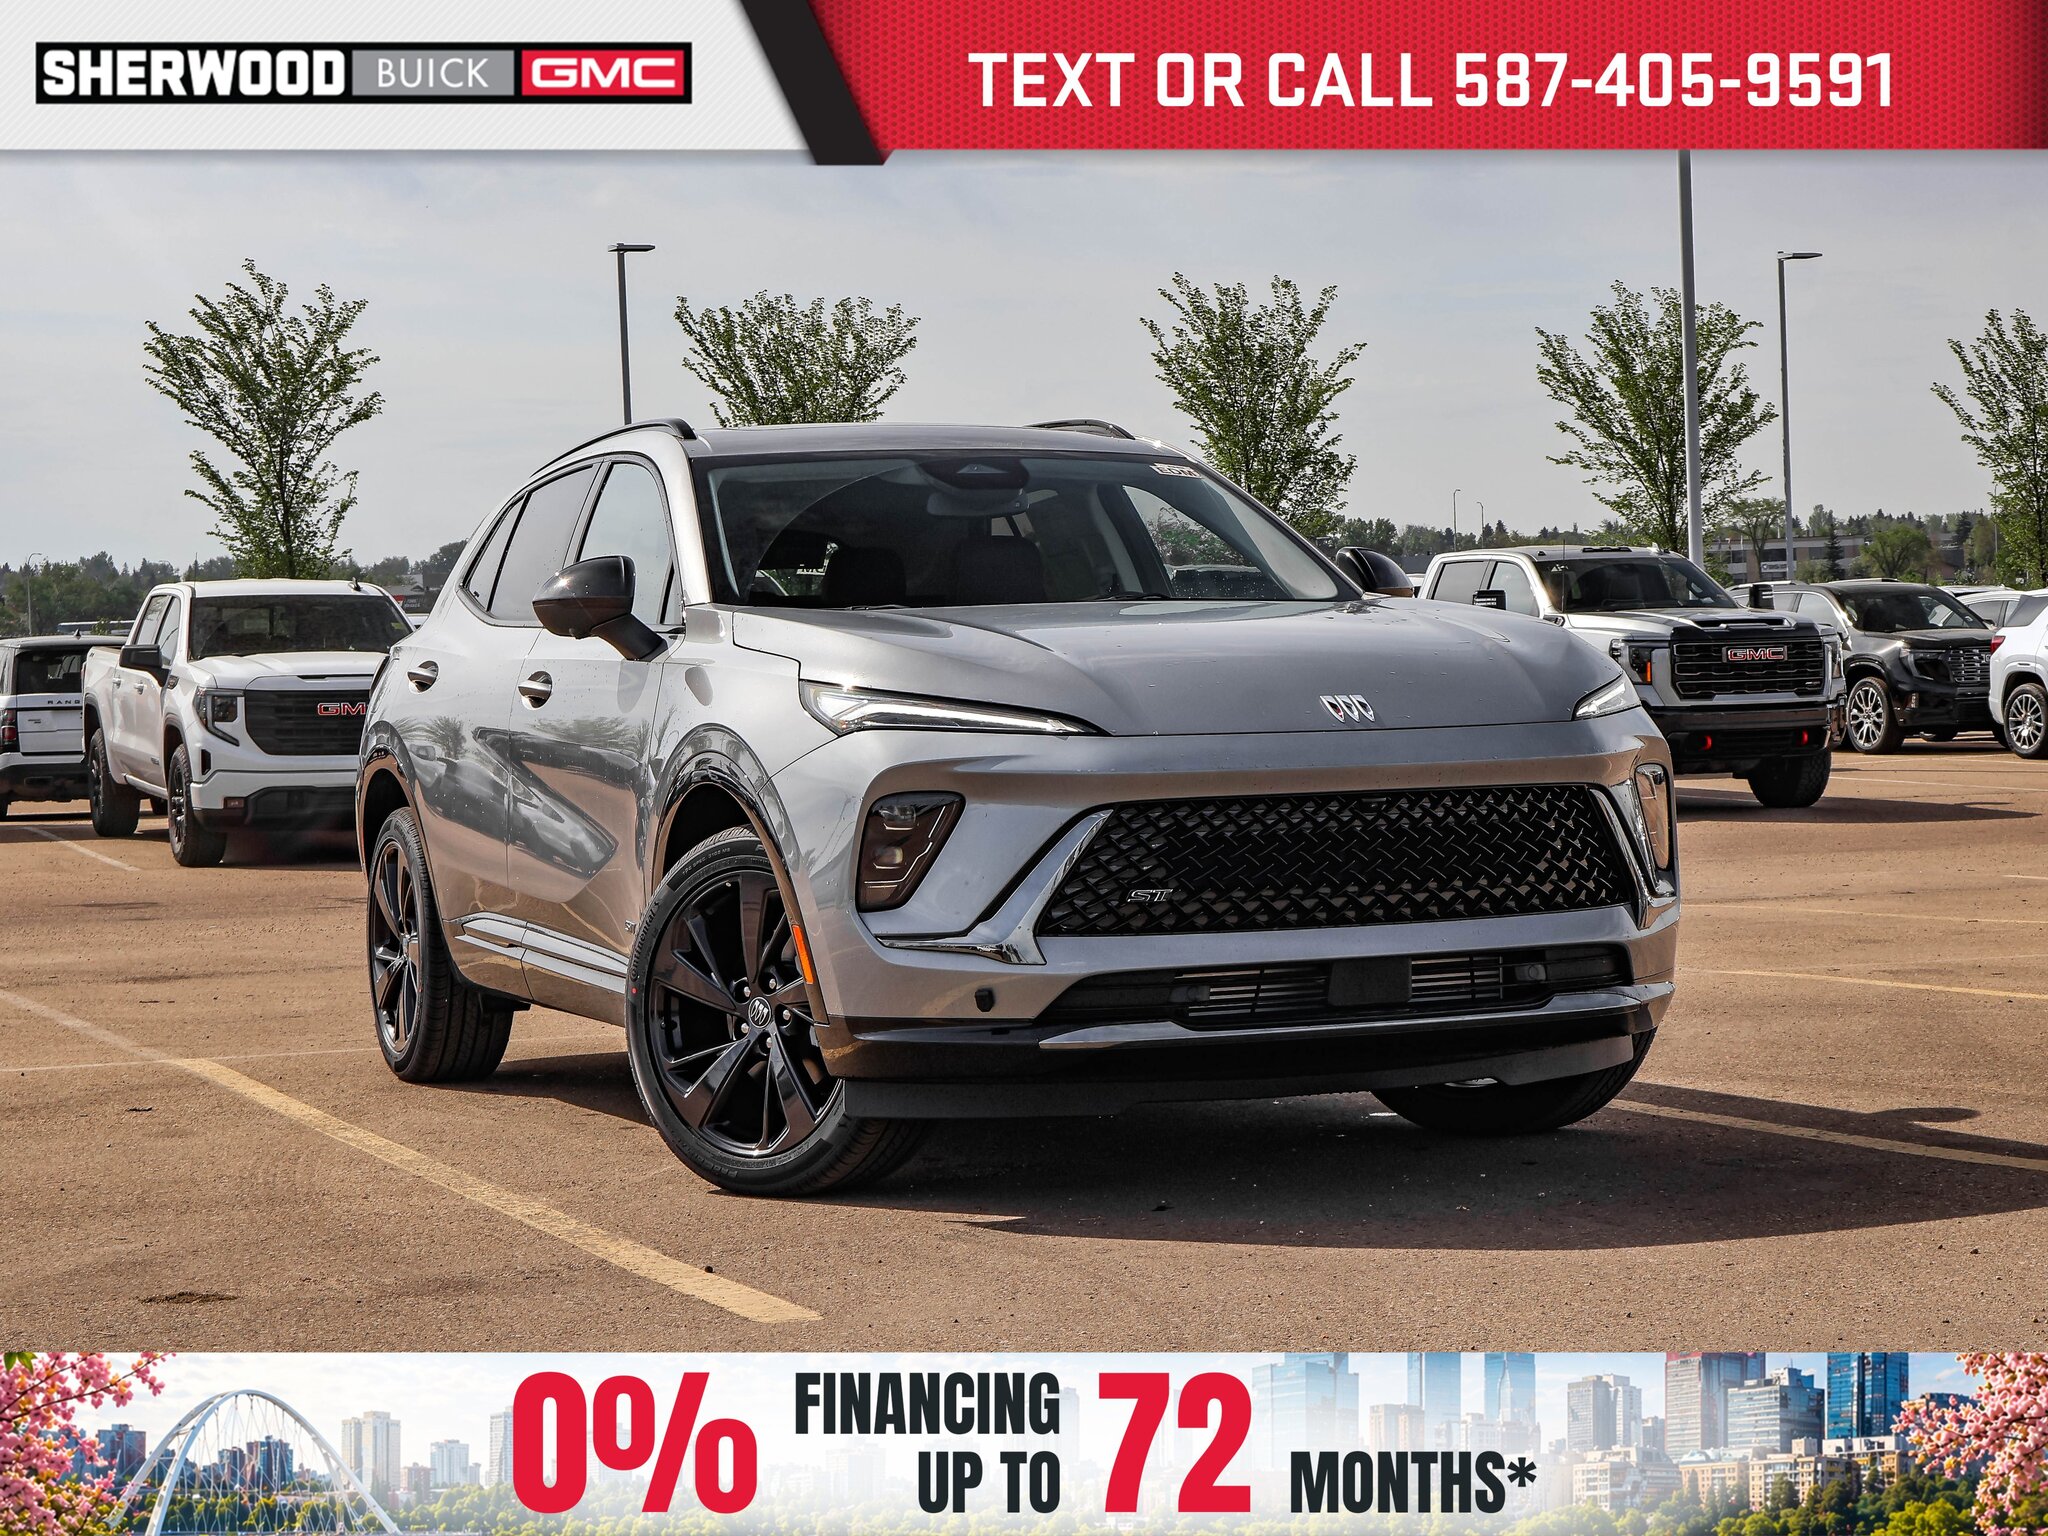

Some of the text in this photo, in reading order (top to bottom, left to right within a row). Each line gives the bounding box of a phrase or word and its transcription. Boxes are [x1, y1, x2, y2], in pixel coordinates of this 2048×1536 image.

[1727, 647, 1784, 660] GMC
[317, 702, 367, 716] GM
[1126, 889, 1174, 902] ST
